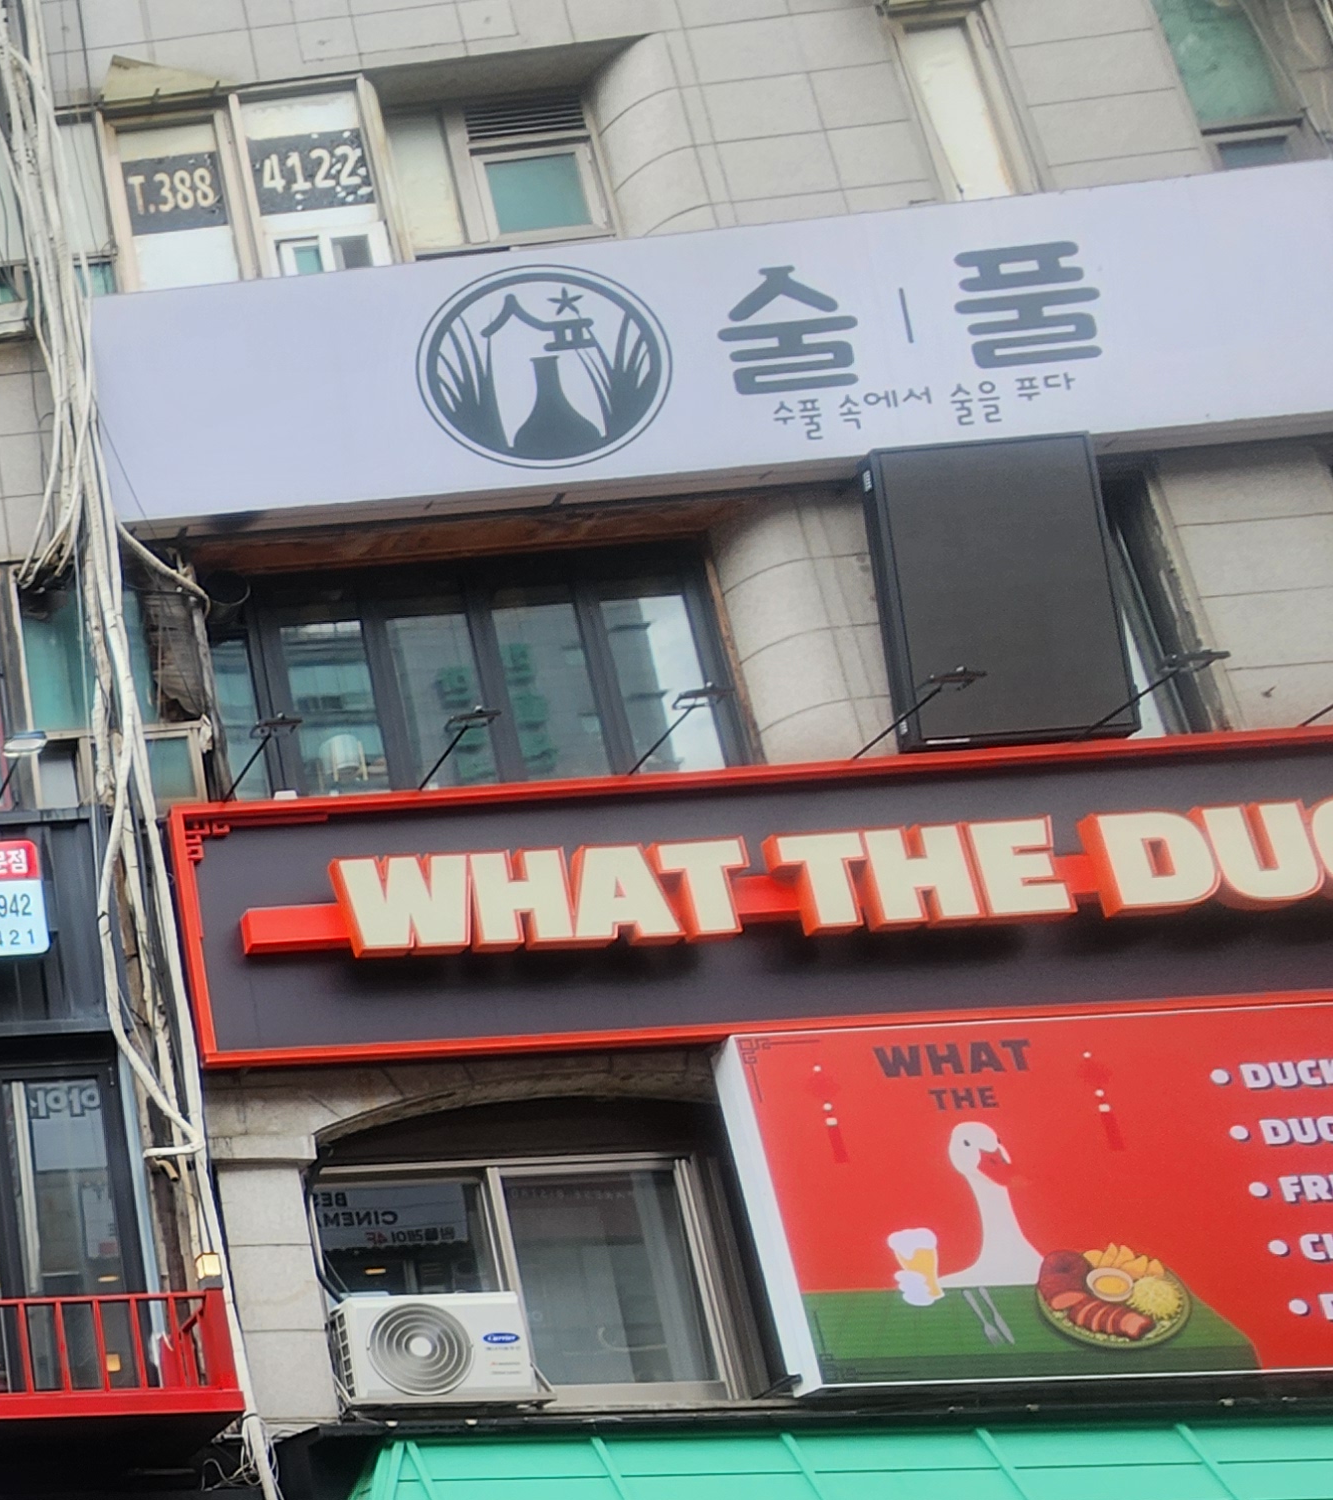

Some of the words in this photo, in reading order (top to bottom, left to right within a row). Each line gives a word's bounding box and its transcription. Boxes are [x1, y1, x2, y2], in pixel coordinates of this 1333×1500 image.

[127, 166, 217, 216] T.388
[261, 144, 367, 194] 4122
[717, 265, 859, 396] 술
[953, 240, 1103, 370] 풀
[772, 399, 823, 441] 수풀
[838, 386, 933, 430] 속에서
[949, 382, 1002, 426] 술을
[1014, 371, 1075, 402] 푸다
[328, 838, 747, 958] WHAT
[761, 814, 1078, 934] THE
[1075, 794, 1333, 917] DU
[873, 1040, 1031, 1078] WHAT
[928, 1086, 1000, 1111] THE
[1278, 1175, 1333, 1203] FR
